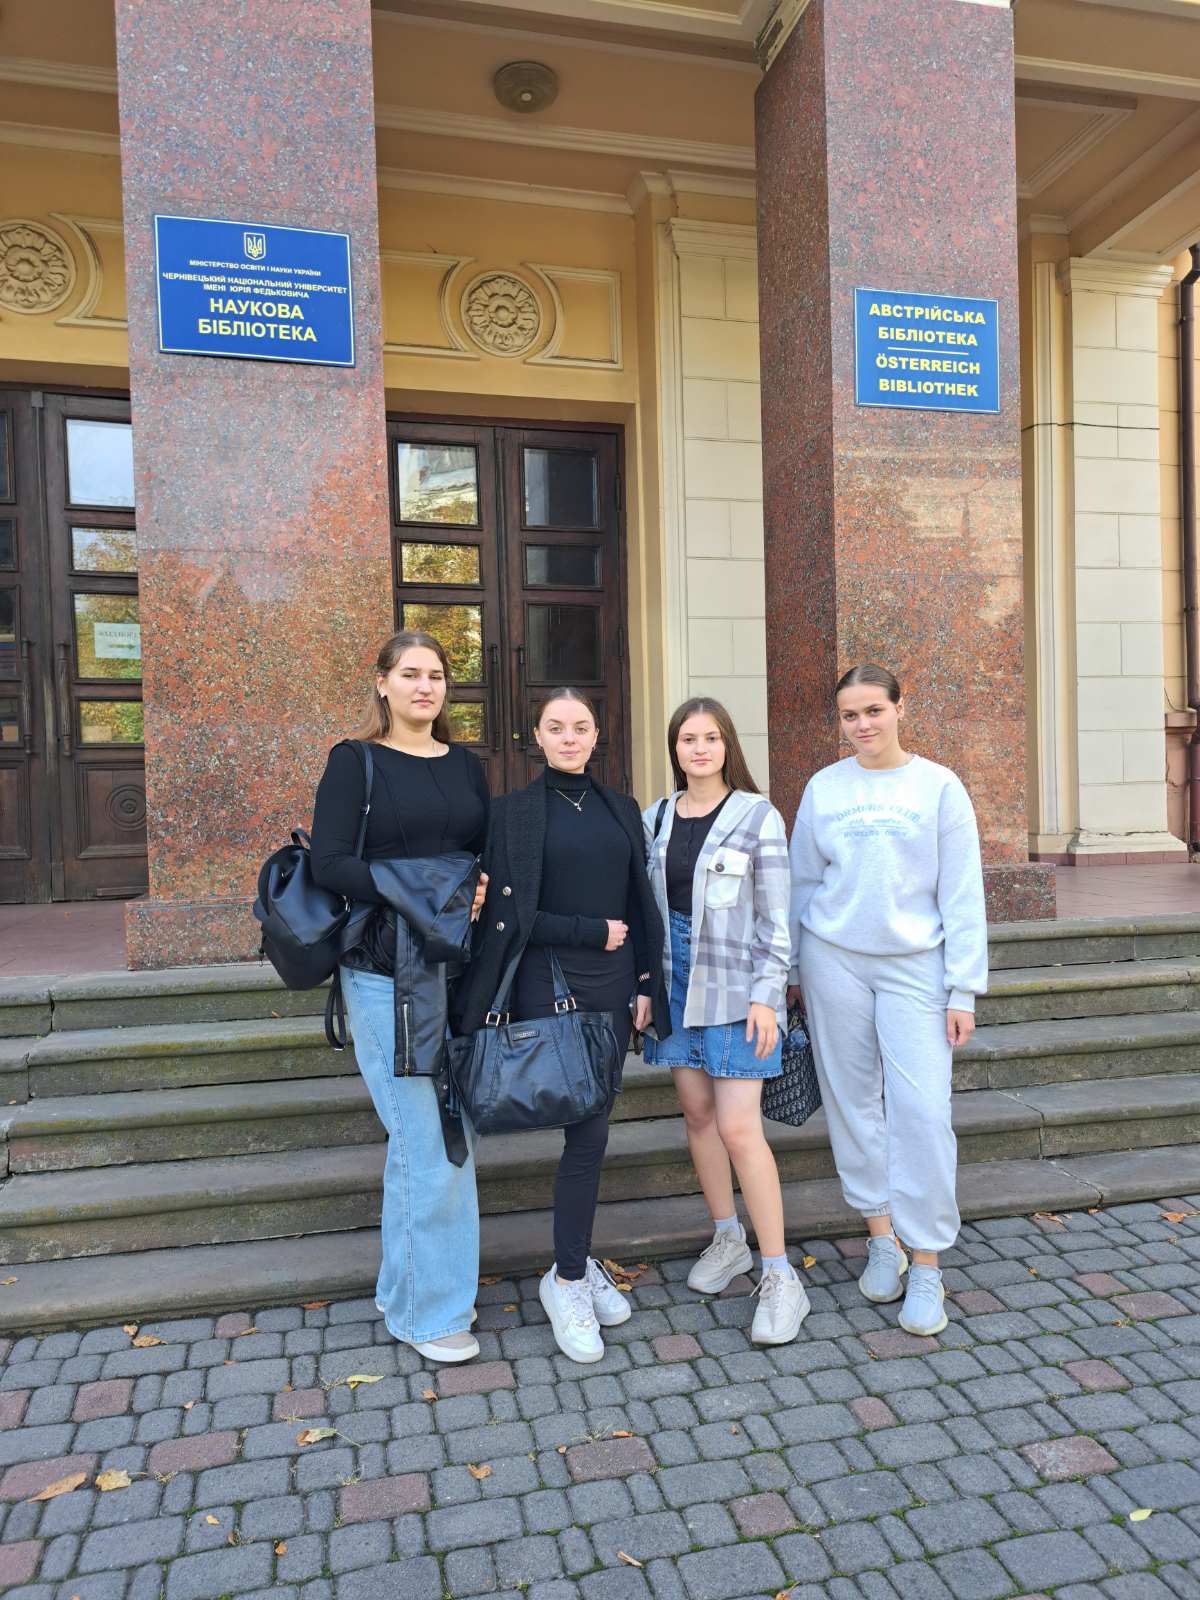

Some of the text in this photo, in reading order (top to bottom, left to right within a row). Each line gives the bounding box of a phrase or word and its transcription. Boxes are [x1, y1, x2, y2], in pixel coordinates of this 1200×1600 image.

[189, 259, 239, 269] МІНІСТЕРСТВО
[240, 263, 266, 272] ОСВІТИ
[270, 265, 293, 274] НАУКИ
[293, 268, 321, 277] УКРАЇНИ
[162, 272, 347, 294] ЧЕРНІВЕЦЬКИЙ НАЦІОНАЛЬНИЙ УНІВЕРСИТЕТ
[203, 283, 309, 299] ІМЕНІ ЮРІЯ ФЕДЬКОВИЧА
[210, 297, 304, 320] НАУКОВА
[869, 303, 986, 325] АВСТРІЙСЬКА
[198, 318, 317, 342] БІБЛІОТЕКА
[878, 326, 978, 346] БІБЛІОТЕКА
[876, 353, 981, 375] ÖSTERREICH
[879, 378, 978, 397] BIBLIOTHEK
